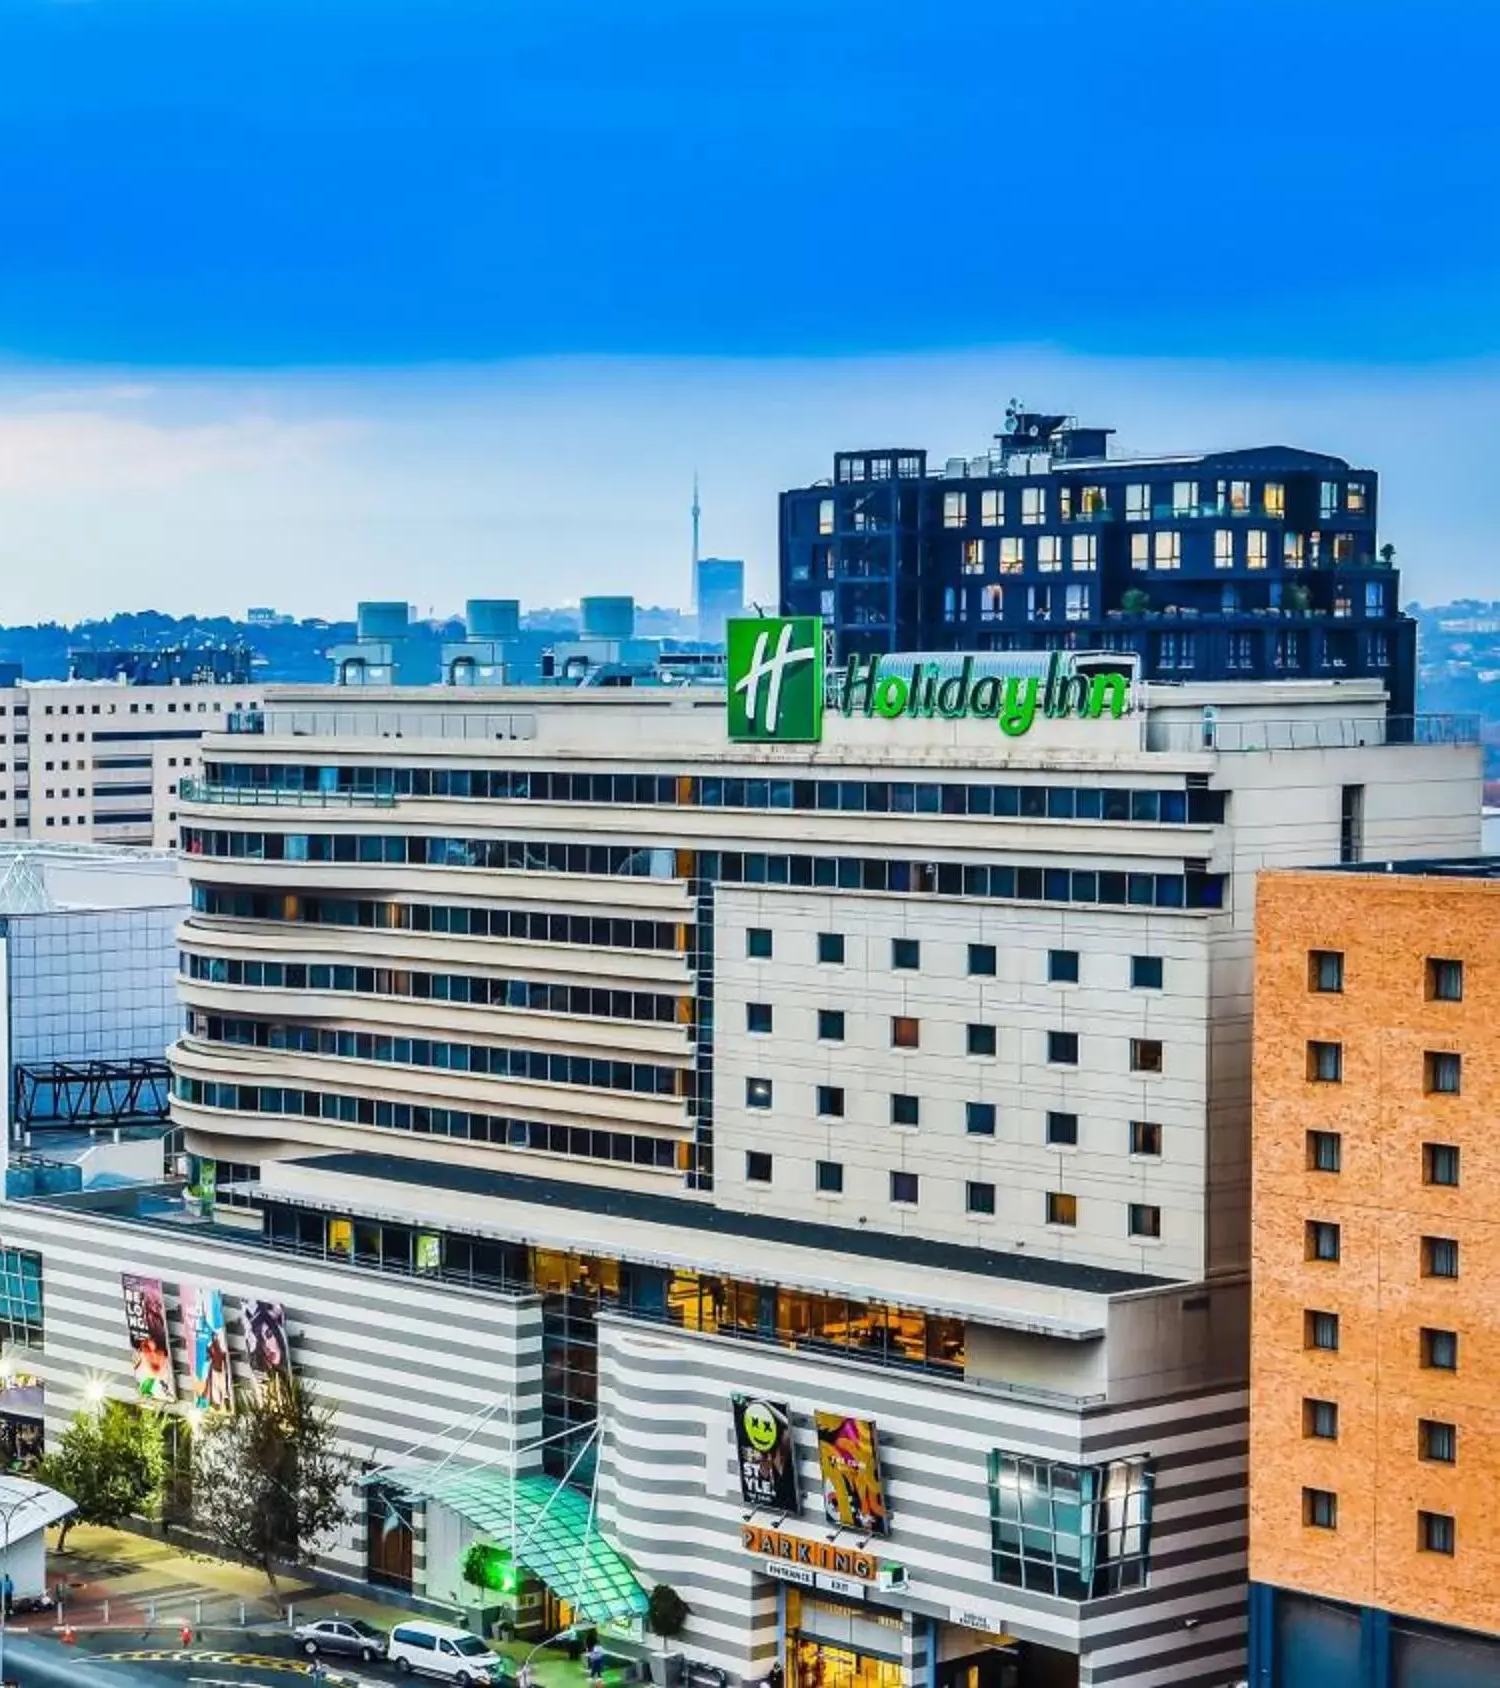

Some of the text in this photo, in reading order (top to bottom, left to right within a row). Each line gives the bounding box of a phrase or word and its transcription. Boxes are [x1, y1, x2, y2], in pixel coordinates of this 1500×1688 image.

[839, 651, 1127, 736] Holiday Inn
[741, 1530, 868, 1577] PARKING
[769, 1565, 810, 1582] ENTRANCE
